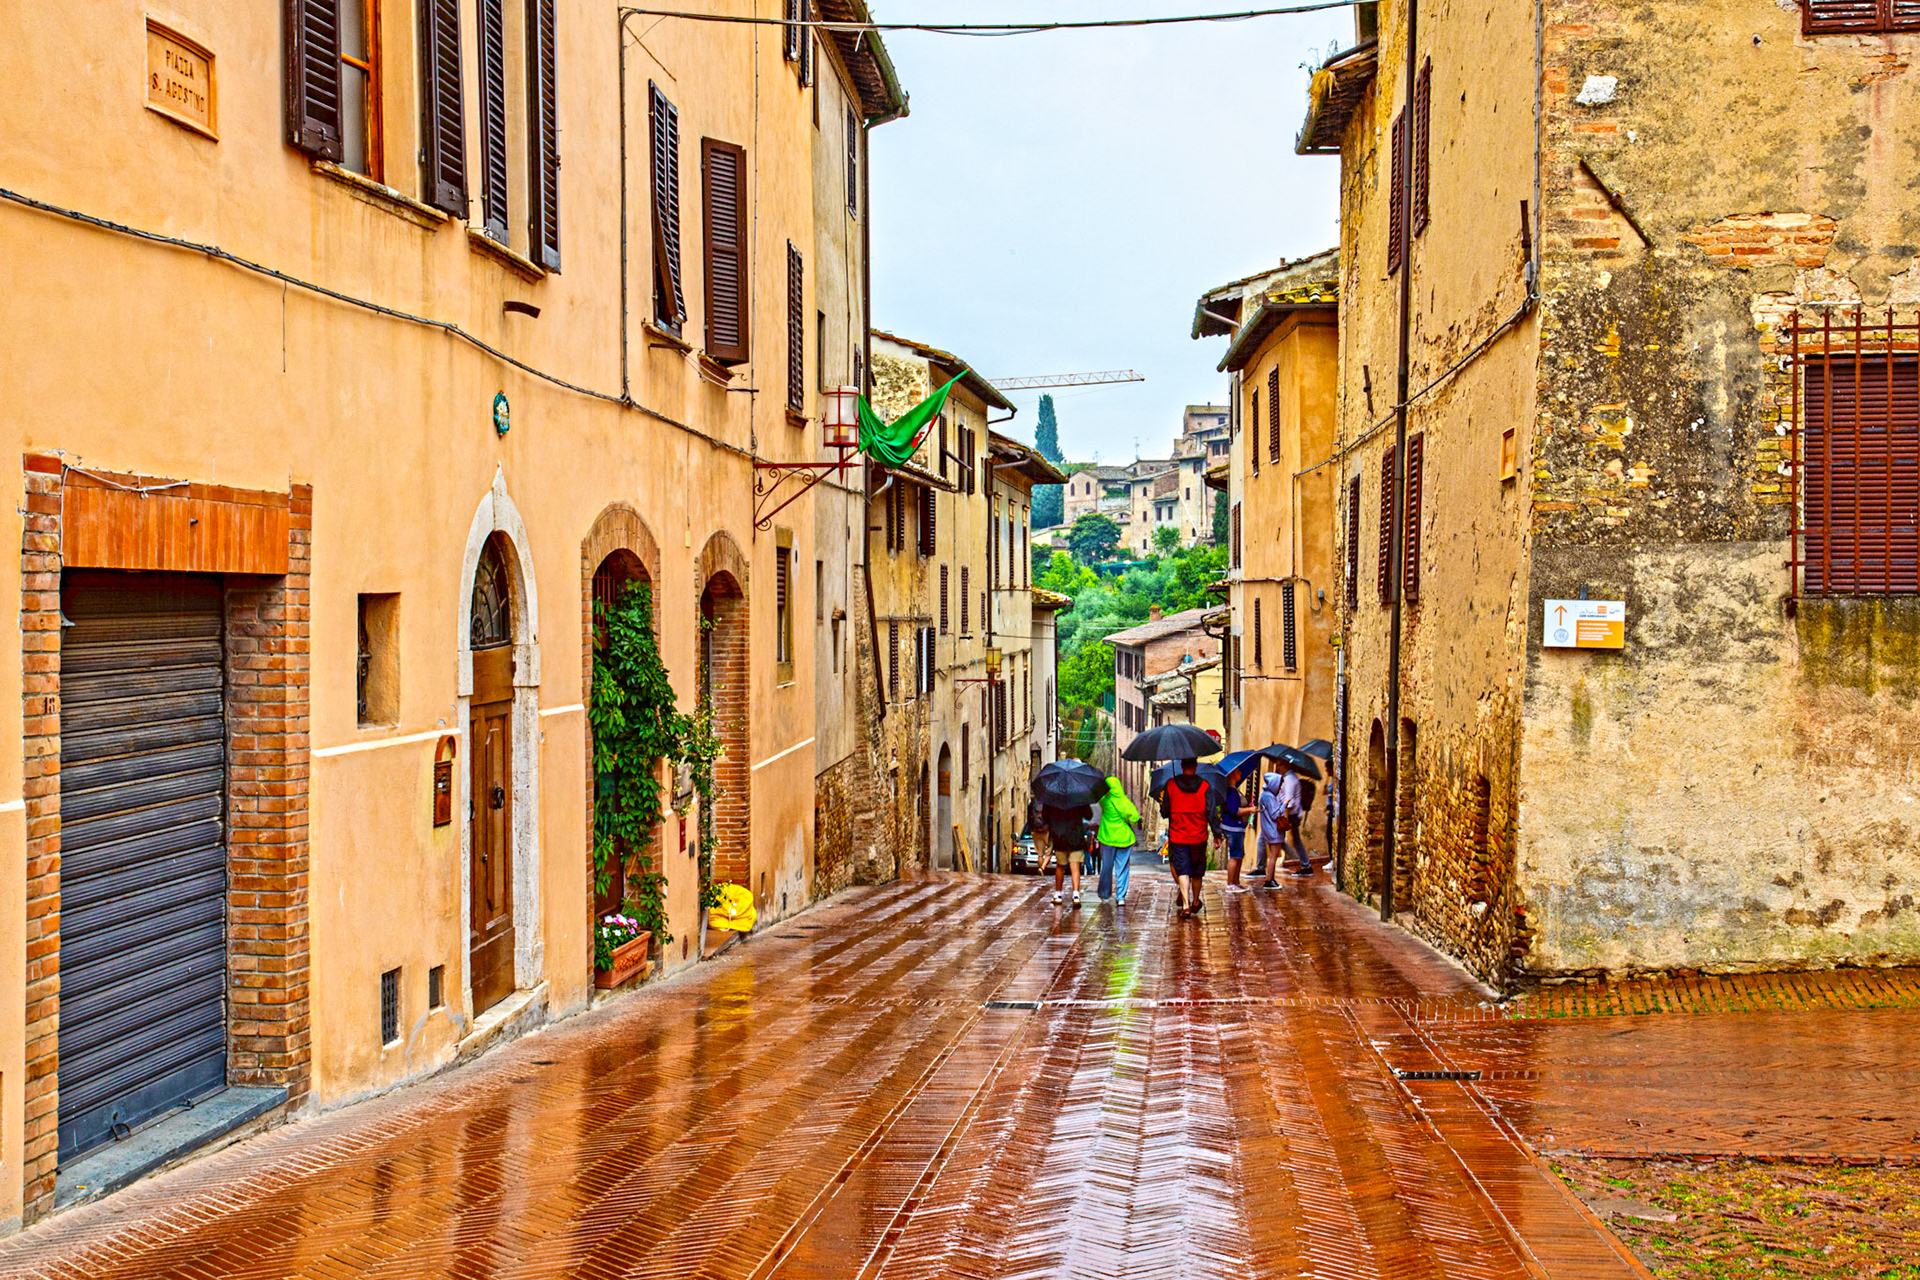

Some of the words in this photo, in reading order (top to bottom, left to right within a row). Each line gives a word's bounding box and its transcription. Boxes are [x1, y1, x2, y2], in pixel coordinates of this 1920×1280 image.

[166, 50, 194, 80] PIAZZA
[152, 72, 162, 91] S.
[166, 78, 204, 112] AGOSTINO
